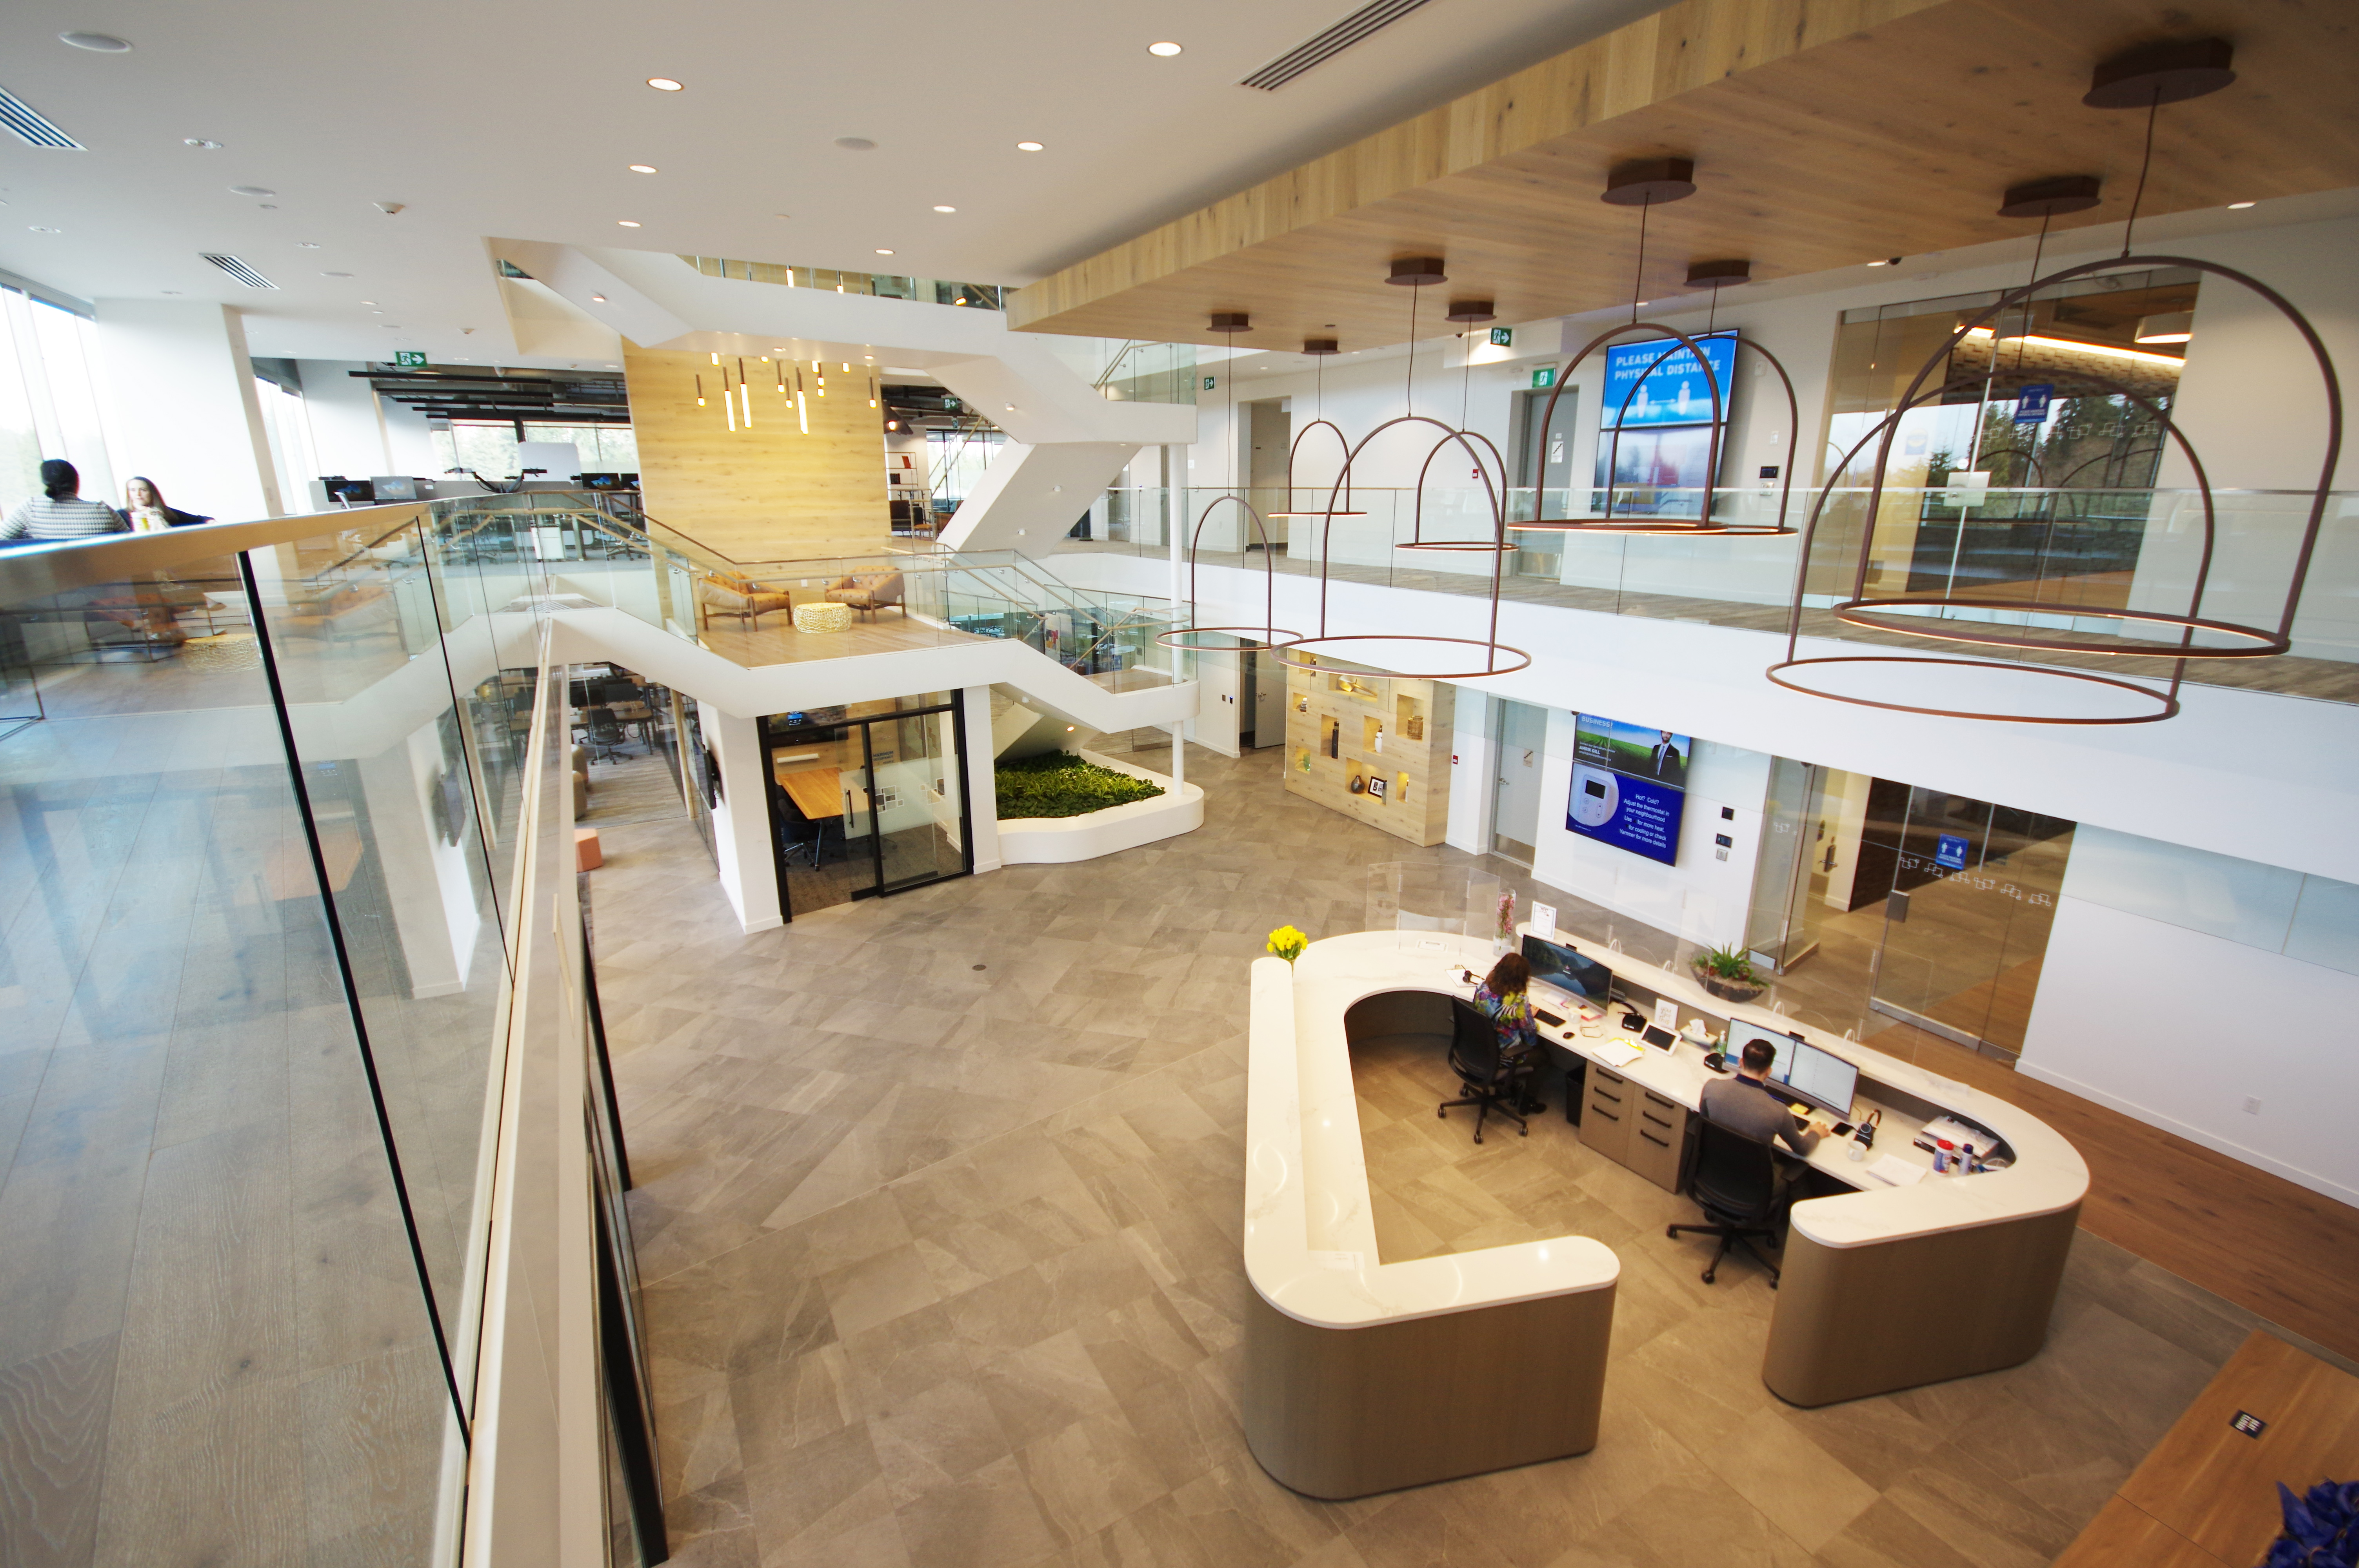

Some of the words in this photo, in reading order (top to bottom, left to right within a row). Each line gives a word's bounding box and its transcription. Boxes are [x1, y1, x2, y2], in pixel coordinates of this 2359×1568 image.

[1616, 352, 1655, 367] PLEASE
[1657, 346, 1711, 361] MAINTN
[1615, 366, 1663, 380] PHYSIAL
[1581, 716, 1613, 728] BUSINESS?
[1644, 804, 1665, 815] thermostat
[1636, 810, 1666, 822] neighbourhood
[1619, 829, 1636, 838] Yammer
[1635, 828, 1649, 836] cooling
